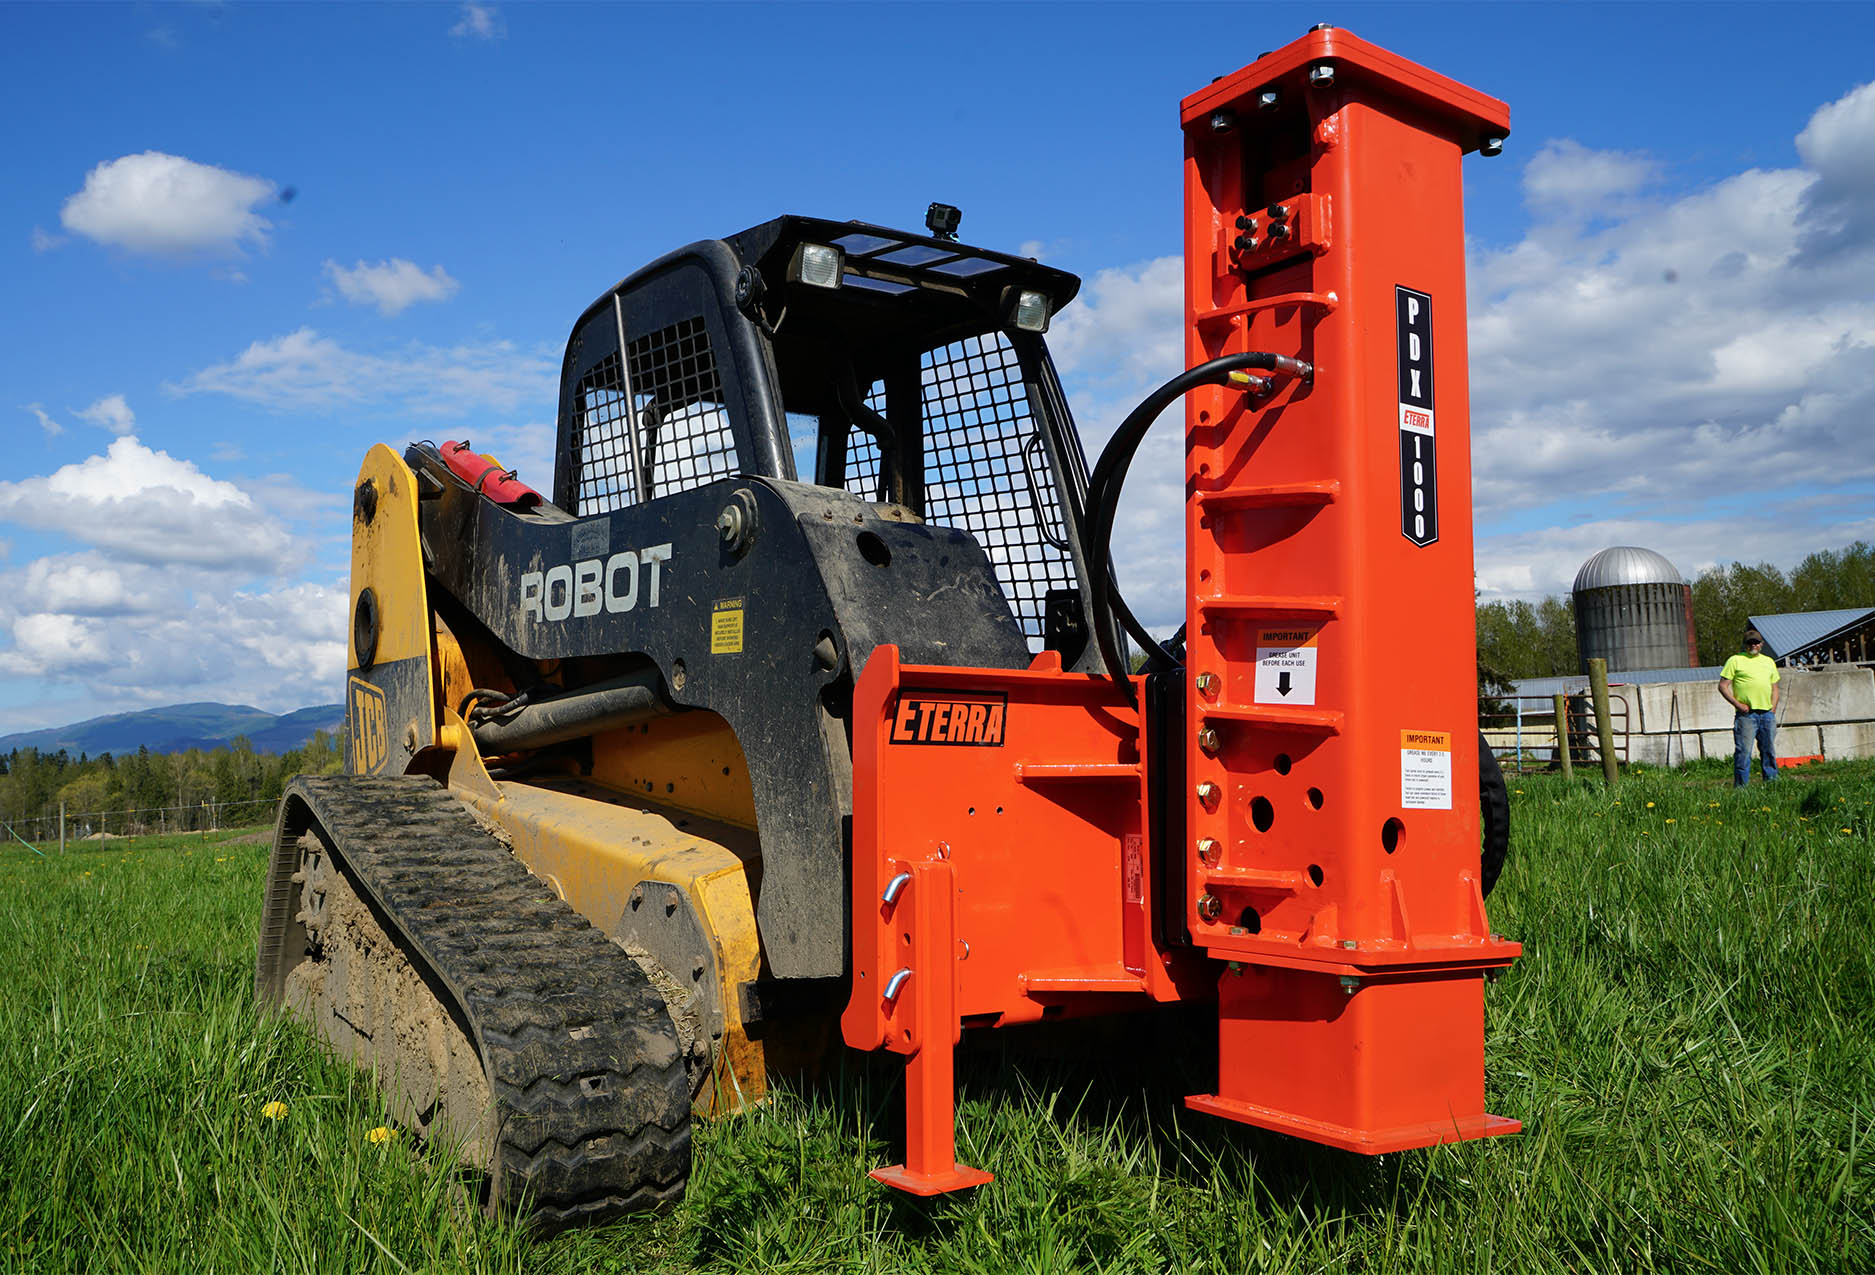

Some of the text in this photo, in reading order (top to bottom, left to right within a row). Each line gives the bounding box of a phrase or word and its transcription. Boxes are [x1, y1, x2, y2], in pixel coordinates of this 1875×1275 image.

[1408, 297, 1421, 398] PDX
[1404, 409, 1430, 429] ETERRA
[1413, 436, 1425, 539] 1000
[520, 543, 673, 623] ROBOT
[720, 600, 742, 609] WARNING
[1263, 632, 1309, 641] IMPORTANT
[355, 688, 386, 775] JCB
[892, 699, 1004, 743] ETERRA
[1406, 734, 1445, 744] IMPORTANT
